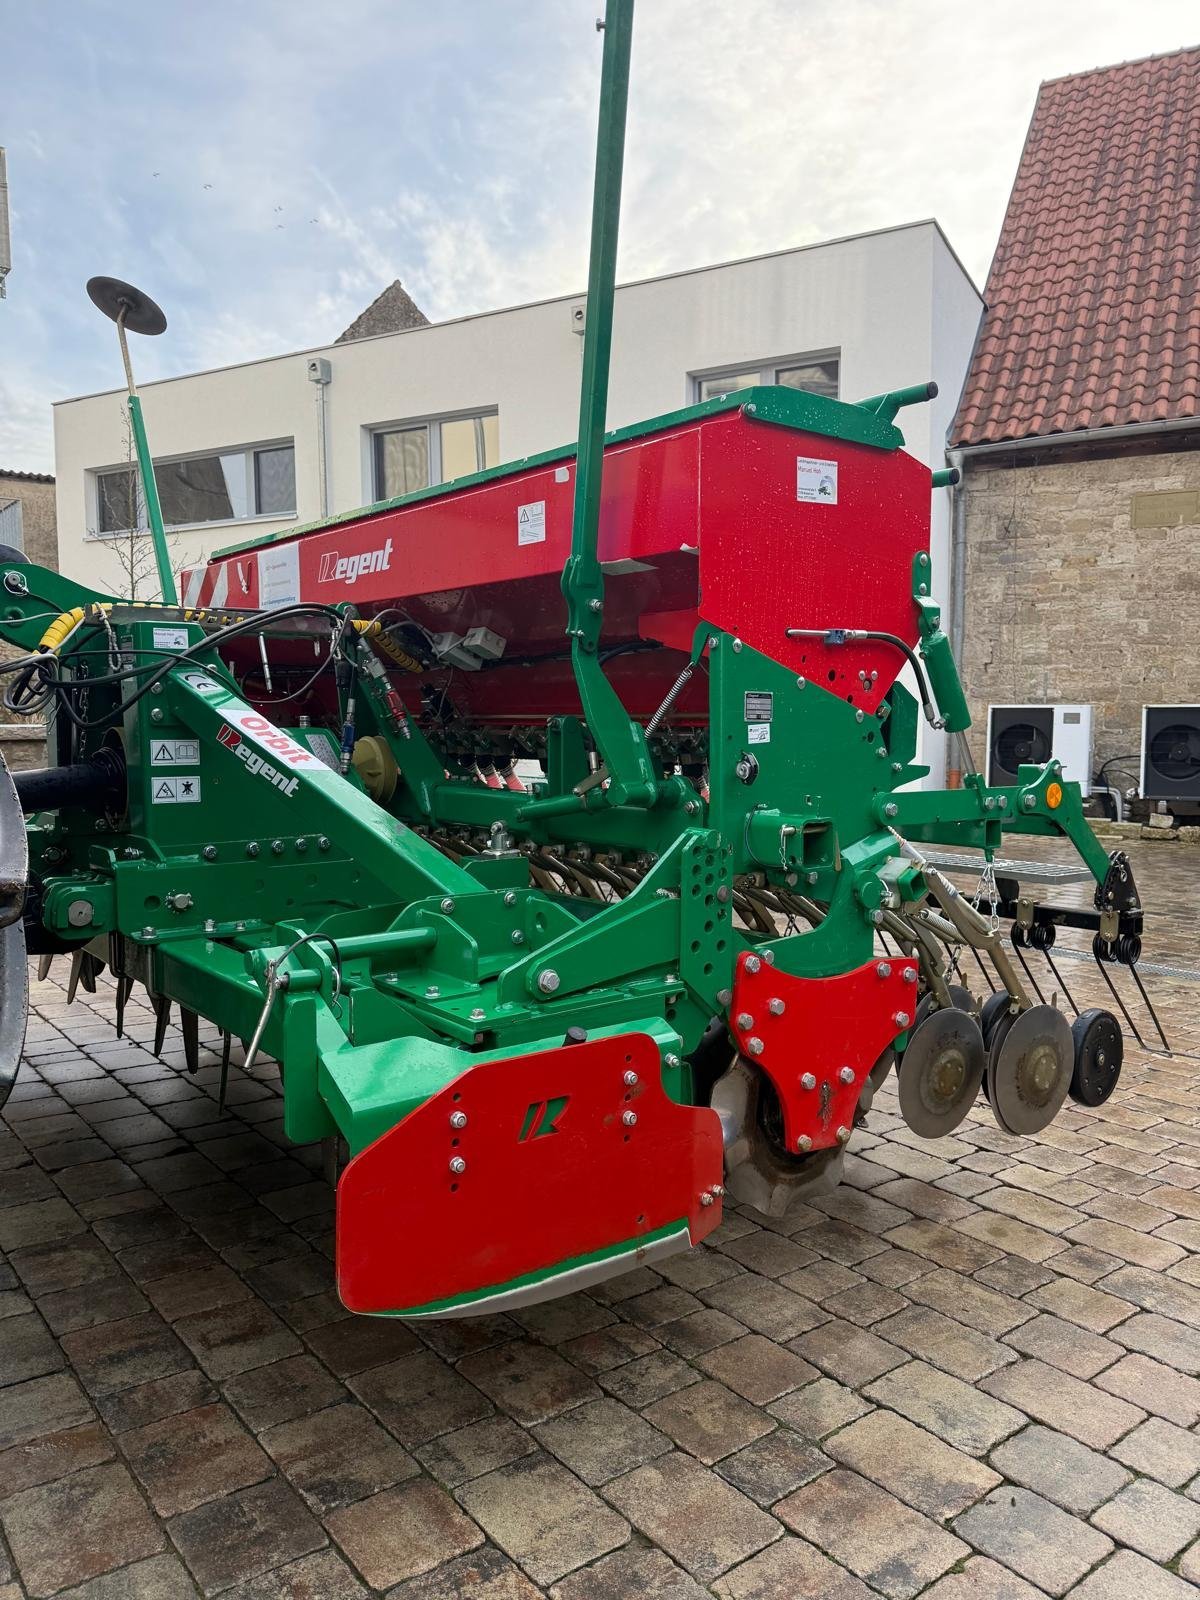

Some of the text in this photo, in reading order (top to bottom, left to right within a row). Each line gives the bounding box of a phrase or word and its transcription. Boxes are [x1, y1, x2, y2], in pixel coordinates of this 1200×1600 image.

[318, 538, 393, 584] Regent
[216, 723, 299, 798] Regent
[240, 717, 312, 764] Orbit
